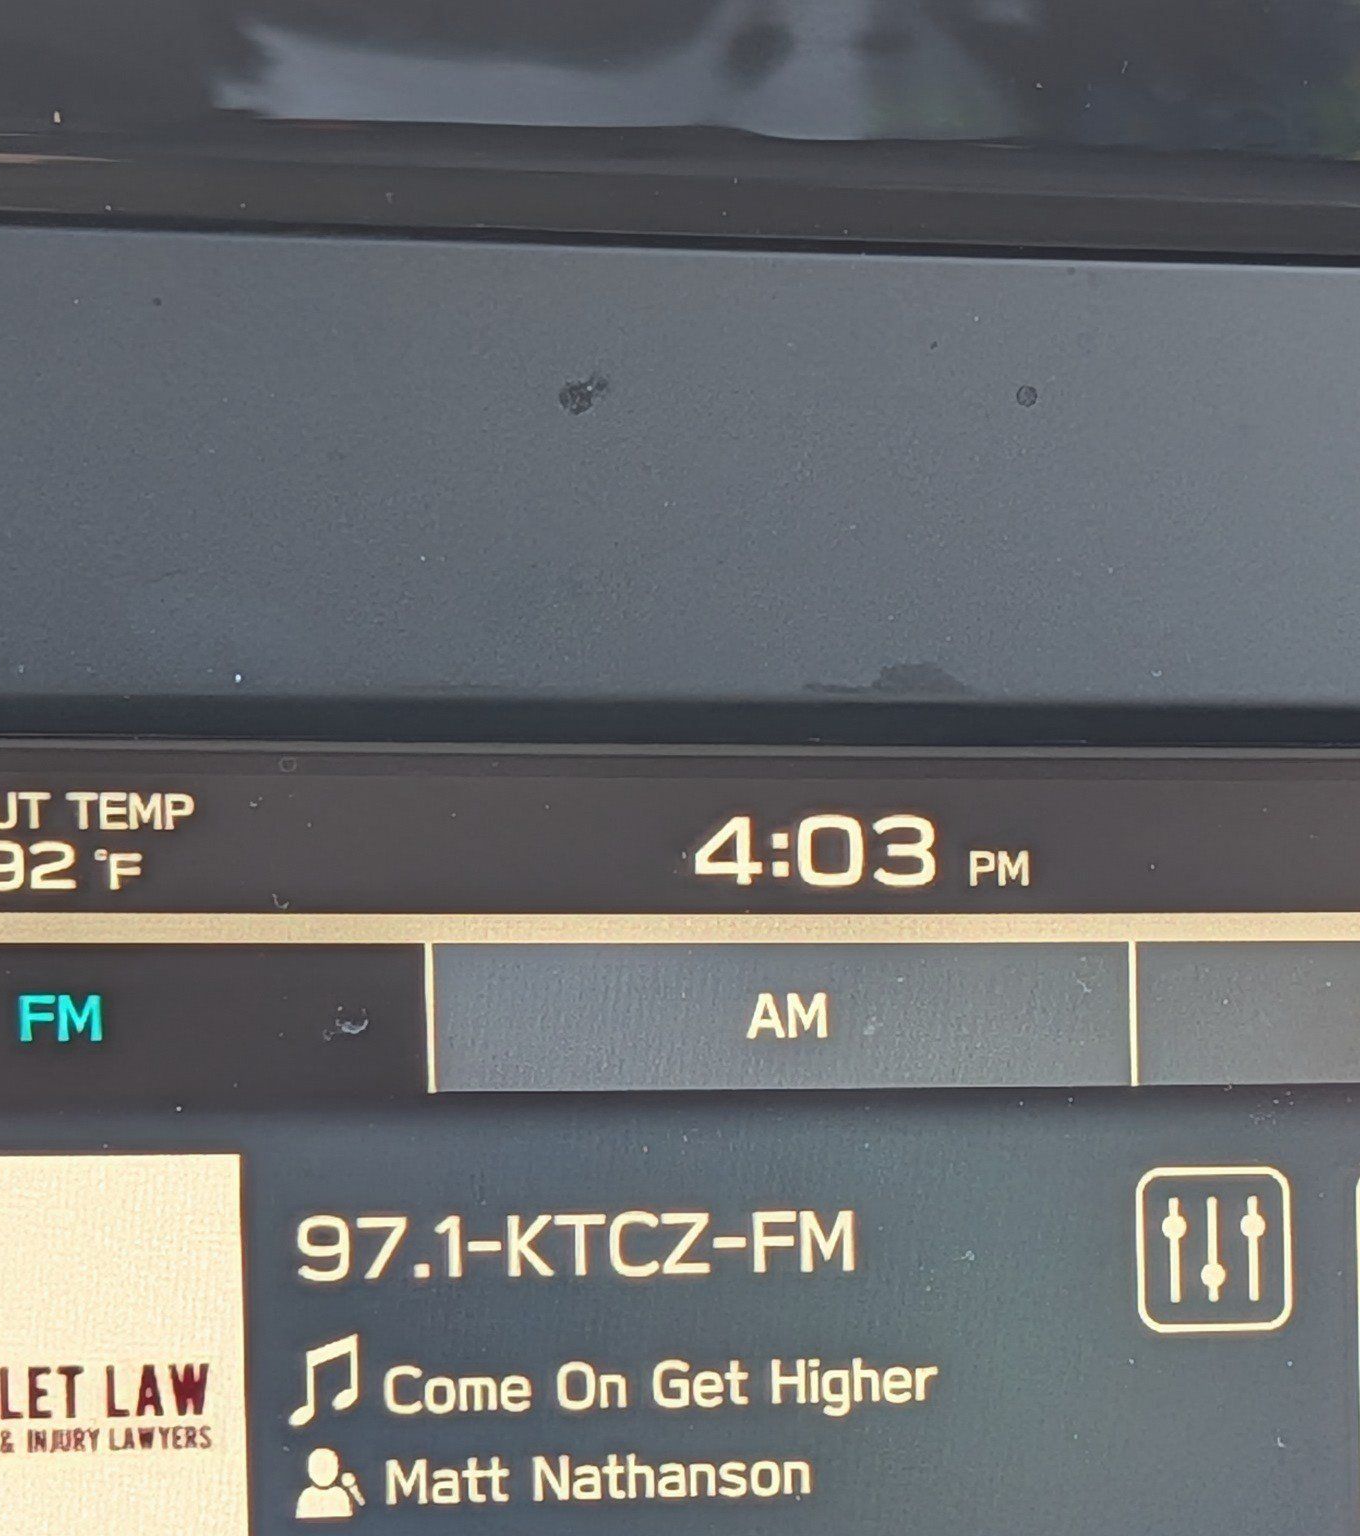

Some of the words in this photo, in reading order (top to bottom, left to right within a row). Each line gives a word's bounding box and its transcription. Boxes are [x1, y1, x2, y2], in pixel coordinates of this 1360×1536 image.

[66, 792, 194, 830] TEMP
[695, 814, 935, 887] 4:03
[970, 851, 1029, 886] PM
[19, 995, 102, 1041] FM
[747, 993, 827, 1039] AM
[297, 1210, 855, 1281] 97.1-KTCZ-FM
[106, 1364, 209, 1417] LAW
[384, 1365, 532, 1414] Come
[557, 1362, 627, 1410] On
[652, 1360, 748, 1408] Get
[771, 1358, 938, 1416] Higher
[0, 1430, 14, 1454] &
[27, 1428, 100, 1453] INJURY
[109, 1426, 212, 1451] LAWYERS
[386, 1457, 509, 1504] Matt
[533, 1453, 811, 1501] Nathanson
